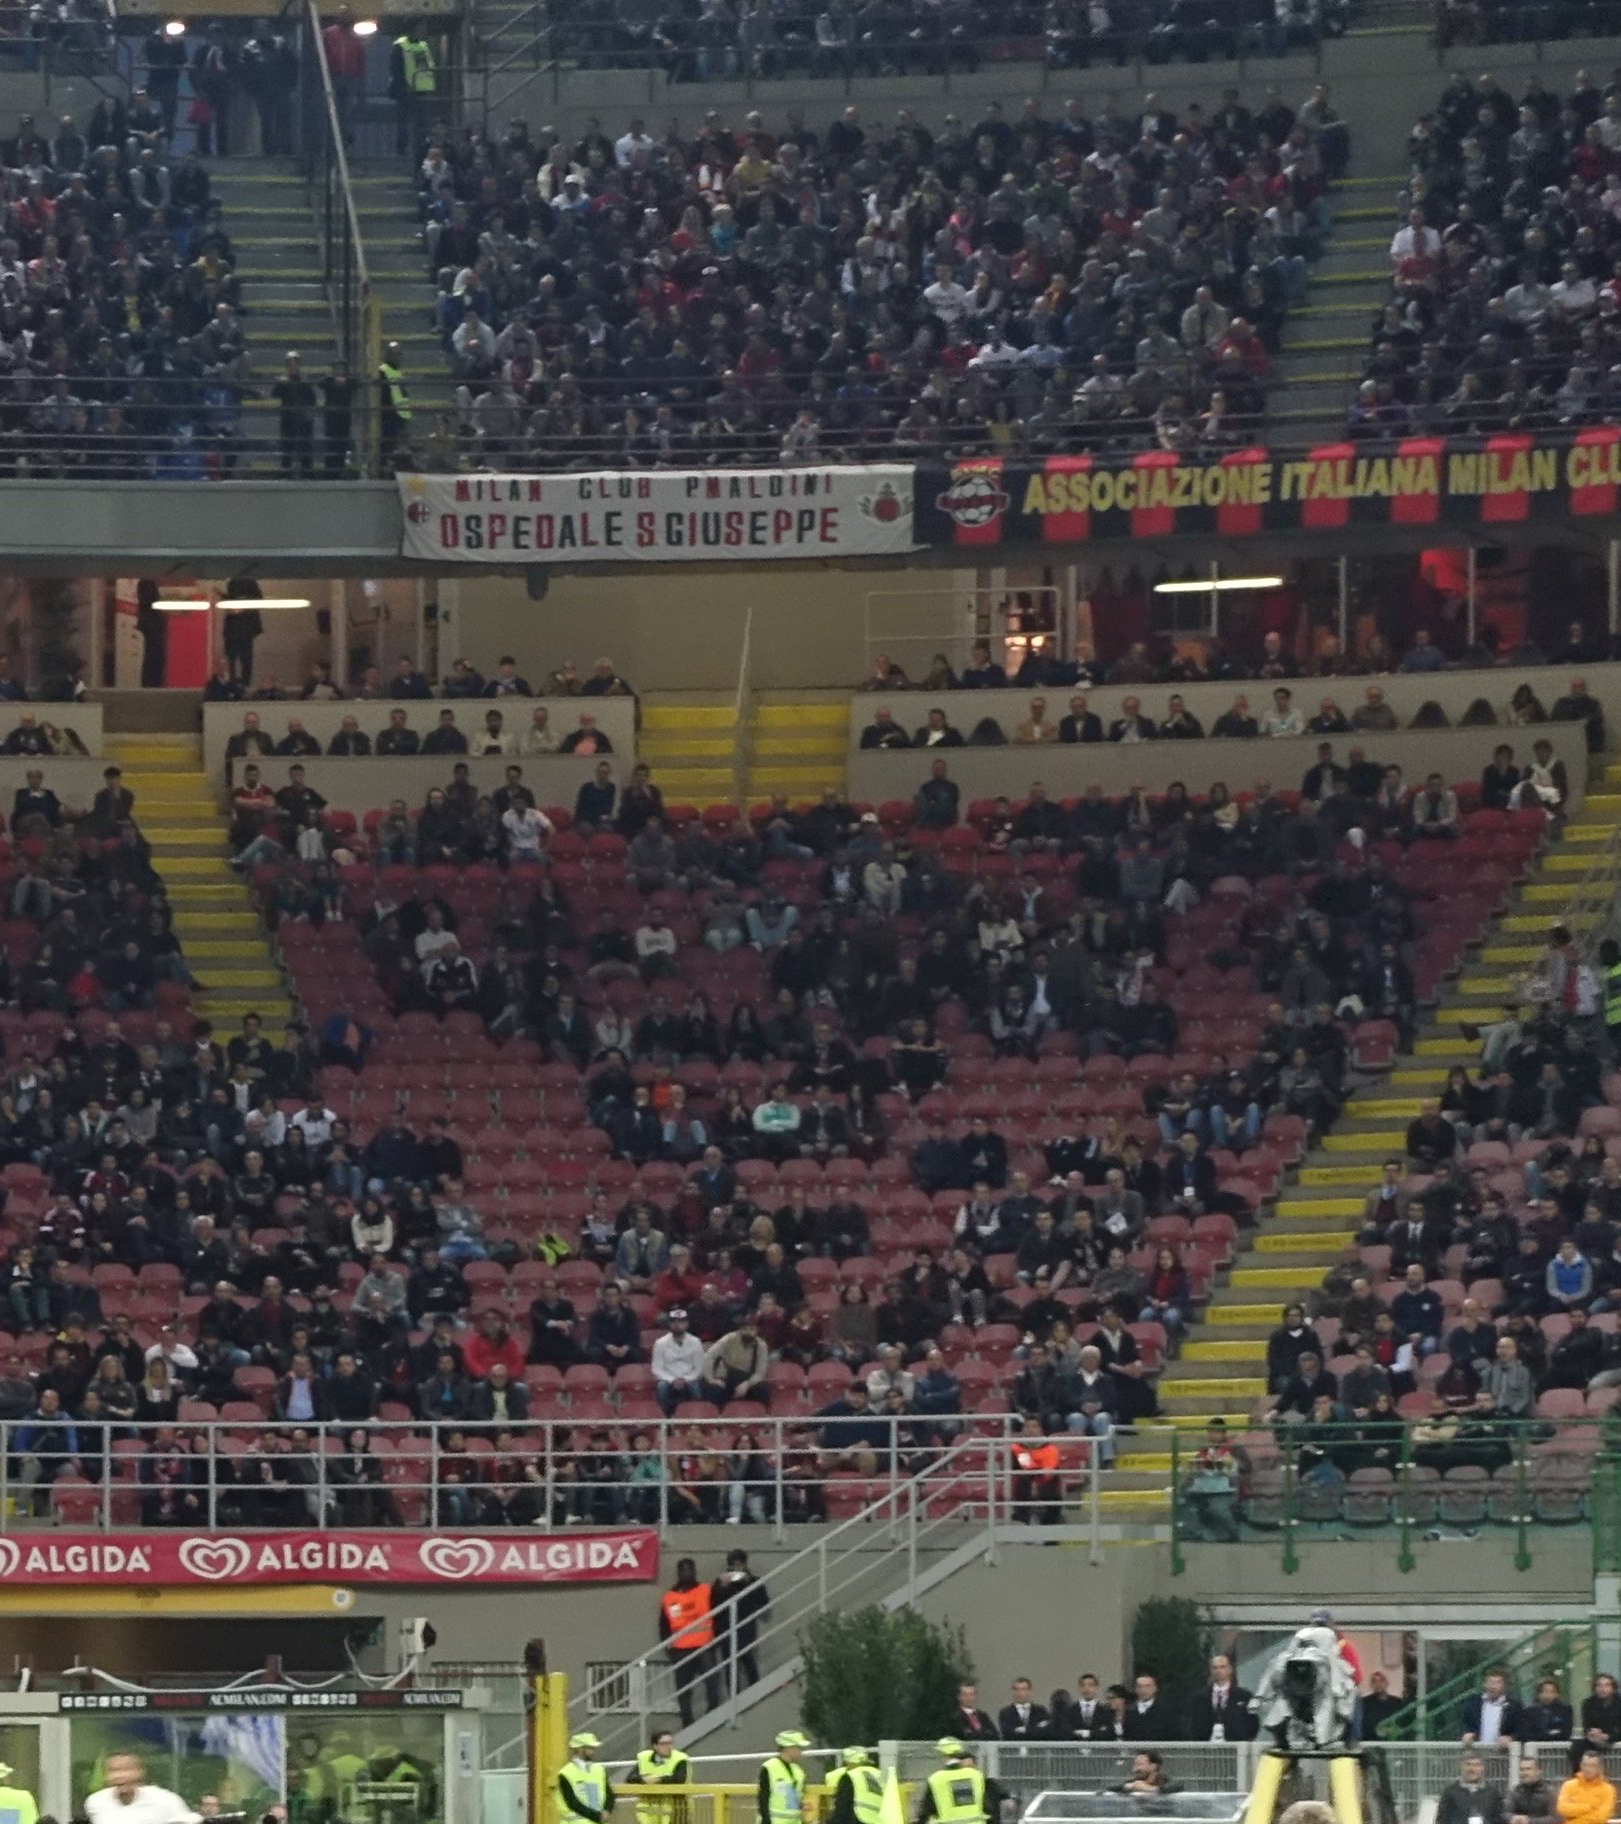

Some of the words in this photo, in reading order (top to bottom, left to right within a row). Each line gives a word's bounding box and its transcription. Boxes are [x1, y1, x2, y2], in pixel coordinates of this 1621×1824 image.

[456, 478, 543, 502] MILAN
[579, 476, 651, 500] CLUB
[1022, 463, 1272, 515] ASSOCIAZIONE
[1279, 455, 1442, 502] ITALIANA
[1447, 448, 1557, 495] MILAN
[439, 510, 624, 550] OSPEDALE
[25, 1543, 145, 1576] ALGIDA
[259, 1542, 386, 1573] ALGIDA
[501, 1540, 637, 1572] ALGIDA
